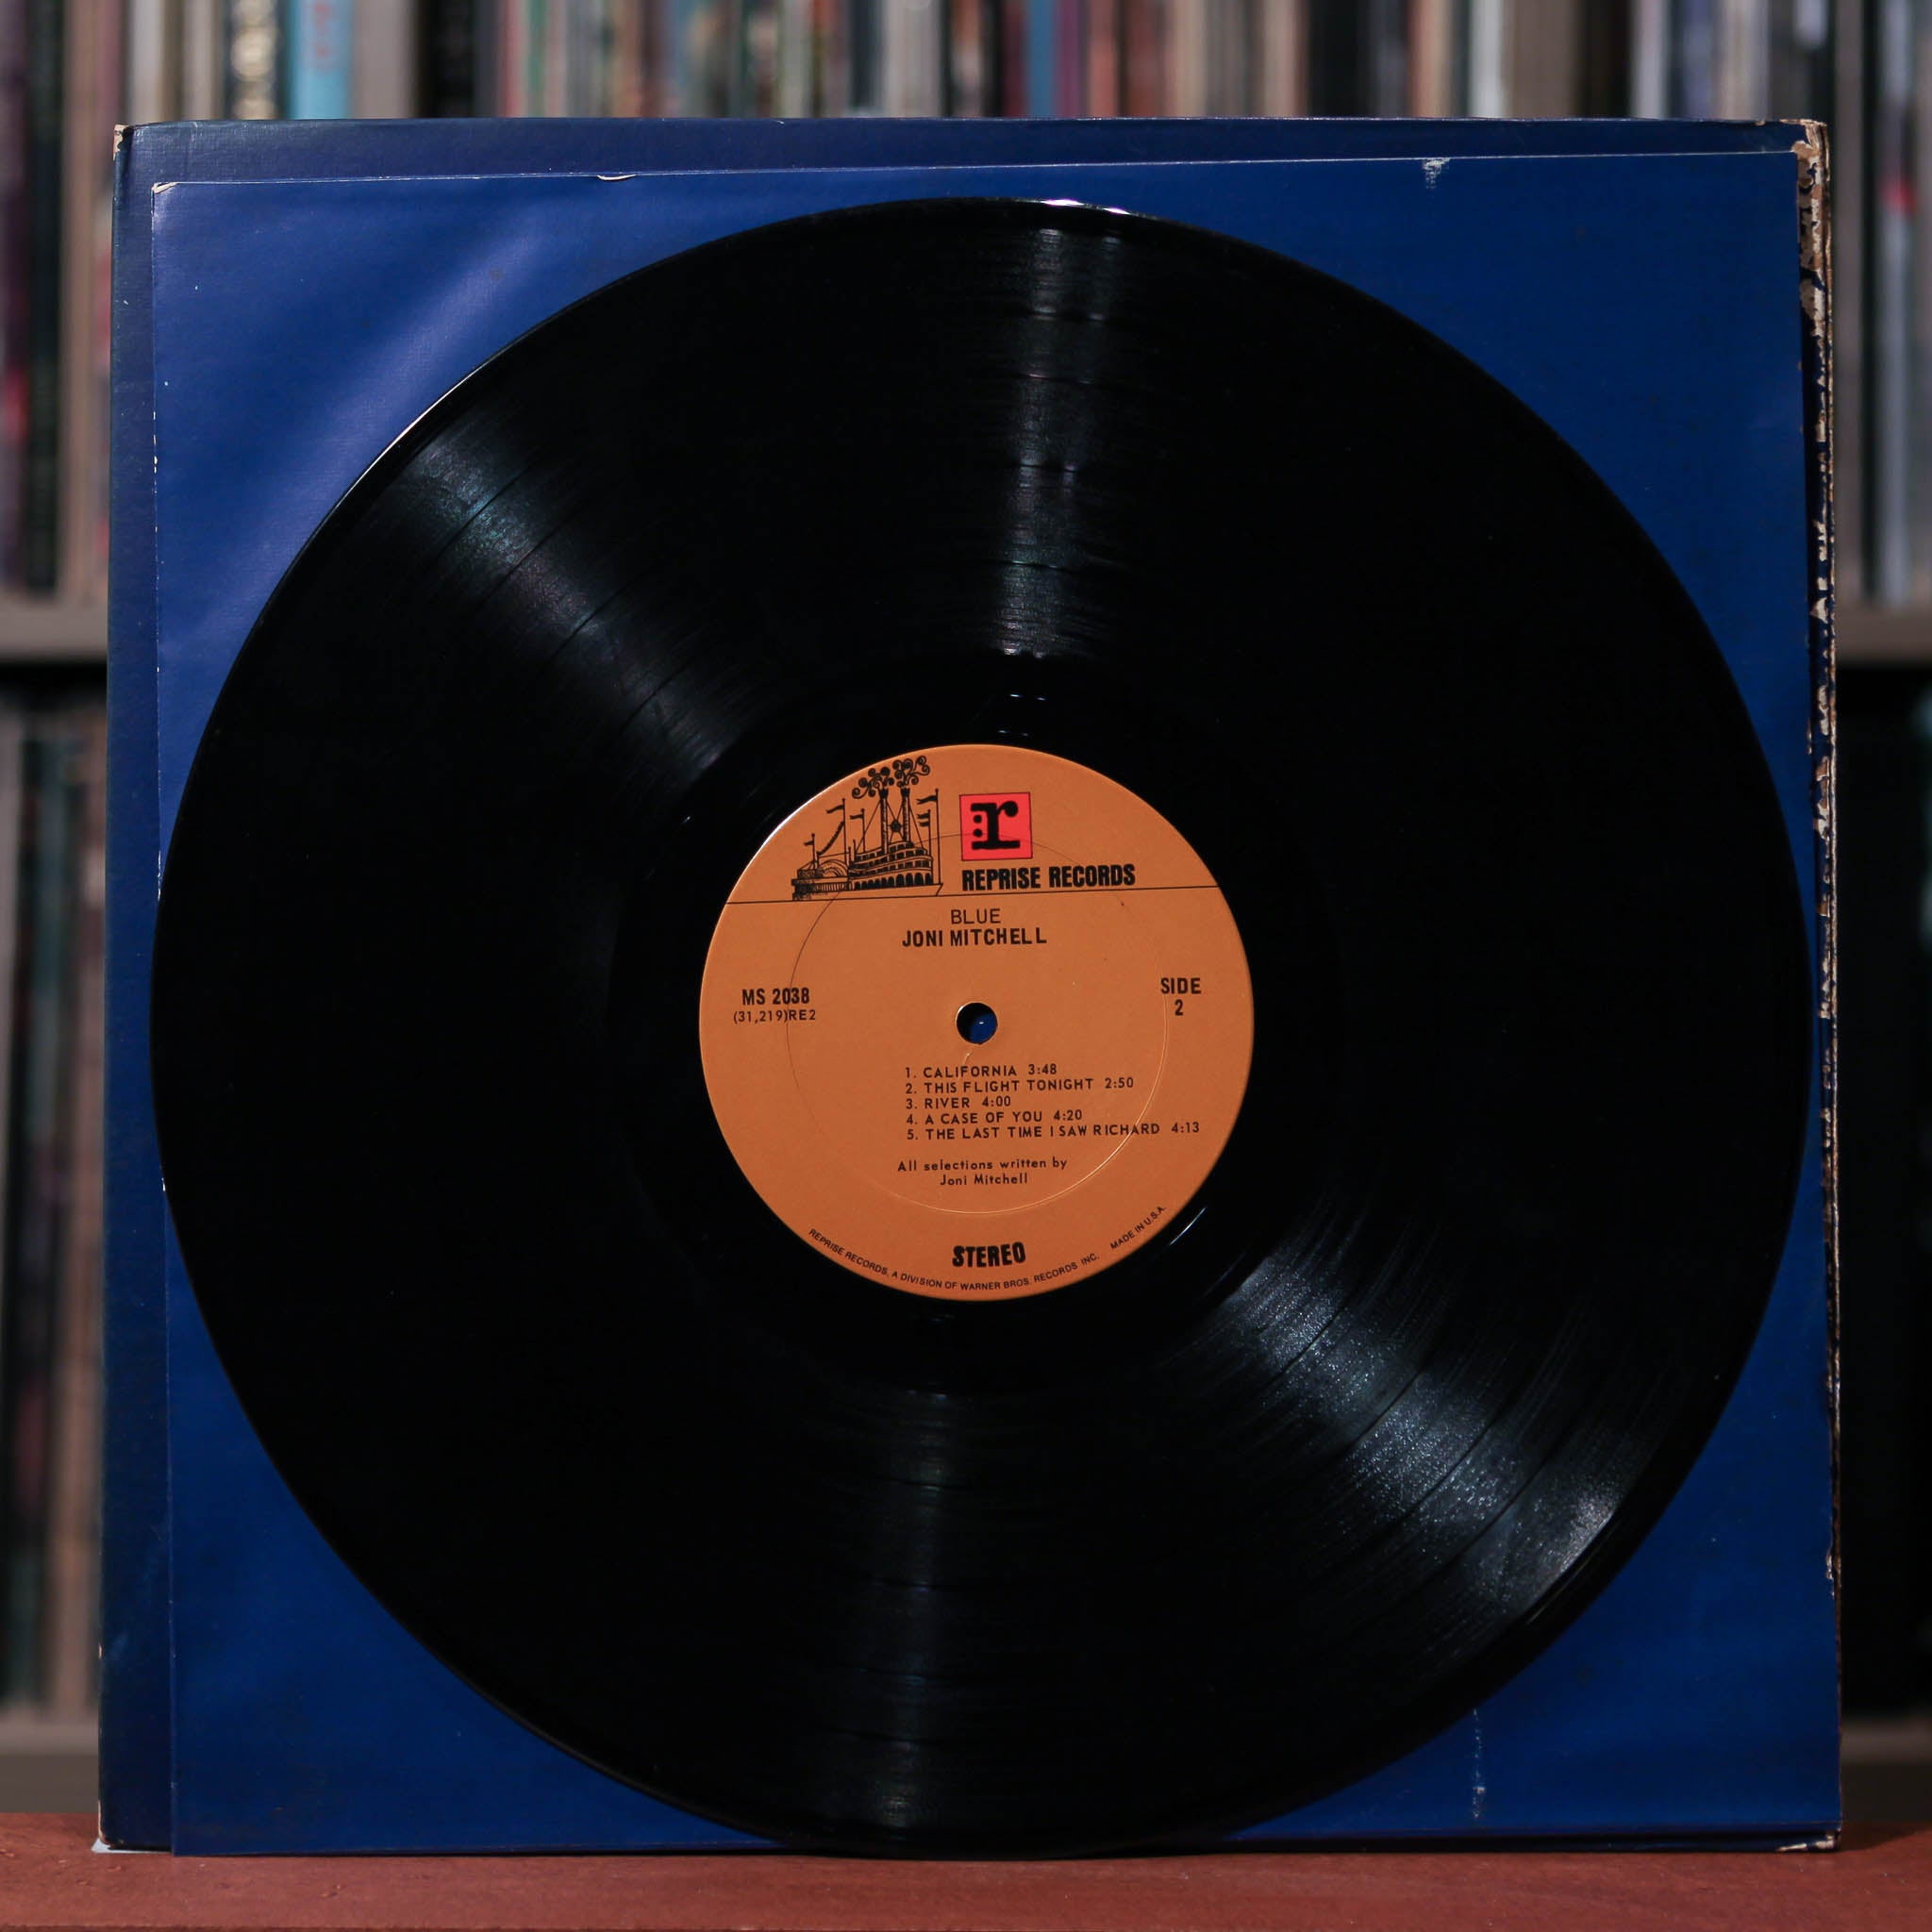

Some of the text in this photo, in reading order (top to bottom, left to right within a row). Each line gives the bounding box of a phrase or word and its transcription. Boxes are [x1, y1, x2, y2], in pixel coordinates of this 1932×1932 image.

[960, 863, 1136, 891] REPRISE RECORDS
[951, 908, 1001, 924] BLUE
[902, 927, 1047, 947] JONI MITCHELL
[1160, 977, 1201, 994] SIDE
[742, 987, 809, 1006] MS 2038
[1174, 999, 1183, 1016] 2
[905, 1062, 1058, 1079] 1. CALIFORNIA 3:48
[905, 1076, 1134, 1095] 2. THIS FLIGHT TONIGHT 2:50
[905, 1094, 1011, 1110] 3. RIVER 4:00
[906, 1108, 1083, 1125] 4. A CASE OF YOU 4:20
[907, 1121, 1200, 1141] 5. THE LAST TIME I SAW RICHARD 4:13
[897, 1156, 1068, 1173] All selections written by
[940, 1172, 1028, 1186] Joni Mitchell
[1110, 1230, 1136, 1250] MADE
[1135, 1222, 1145, 1233] IN
[808, 1228, 845, 1256] REPRISE
[900, 1273, 943, 1289] DIVISION
[1034, 1261, 1079, 1283] RECORDS
[1081, 1253, 1100, 1266] INC.
[952, 1241, 1025, 1268] STEREO
